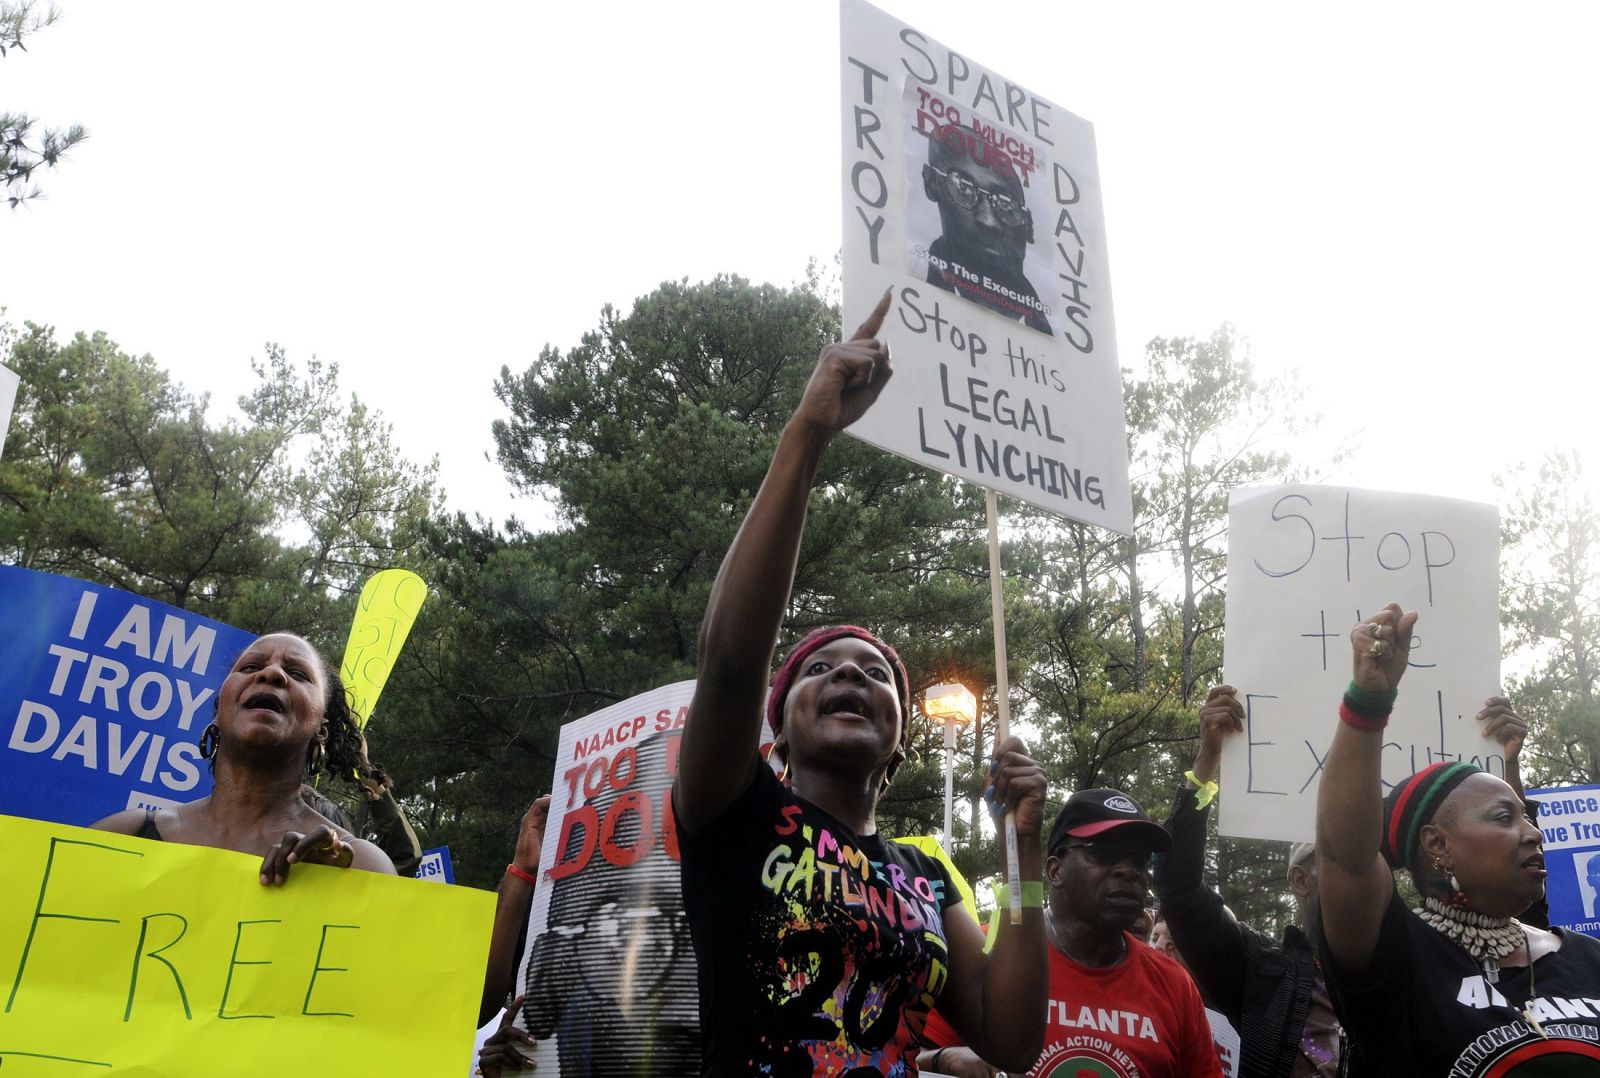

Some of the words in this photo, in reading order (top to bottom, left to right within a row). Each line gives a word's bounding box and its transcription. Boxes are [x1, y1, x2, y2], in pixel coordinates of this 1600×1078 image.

[900, 28, 1054, 147] SPARE
[917, 86, 961, 126] TOO
[971, 114, 1035, 166] MUCH
[848, 56, 889, 265] TROY
[915, 246, 948, 270] Stop
[951, 262, 980, 284] The
[983, 275, 1052, 315] Execution
[1053, 162, 1094, 354] DAVIS
[898, 287, 987, 368] Stop
[1004, 338, 1066, 393] this
[939, 362, 1065, 443] LEGAL
[918, 406, 1105, 511] LYNCHING
[1254, 492, 1456, 608] Stop
[69, 590, 98, 640] I
[105, 604, 217, 676] AM
[1300, 609, 1437, 671] te
[48, 643, 215, 731] TROY
[8, 700, 202, 792] DAVIS
[573, 715, 647, 761] NAACP
[654, 706, 689, 732] SA
[563, 747, 637, 808] TOO
[1538, 797, 1599, 817] cence
[415, 858, 442, 879] ers!
[1570, 822, 1600, 840] Tro
[5, 837, 361, 1022] FREE
[1046, 999, 1159, 1043] TLANTA
[1066, 1035, 1112, 1053] ACTION
[1112, 1047, 1140, 1078] NETW
